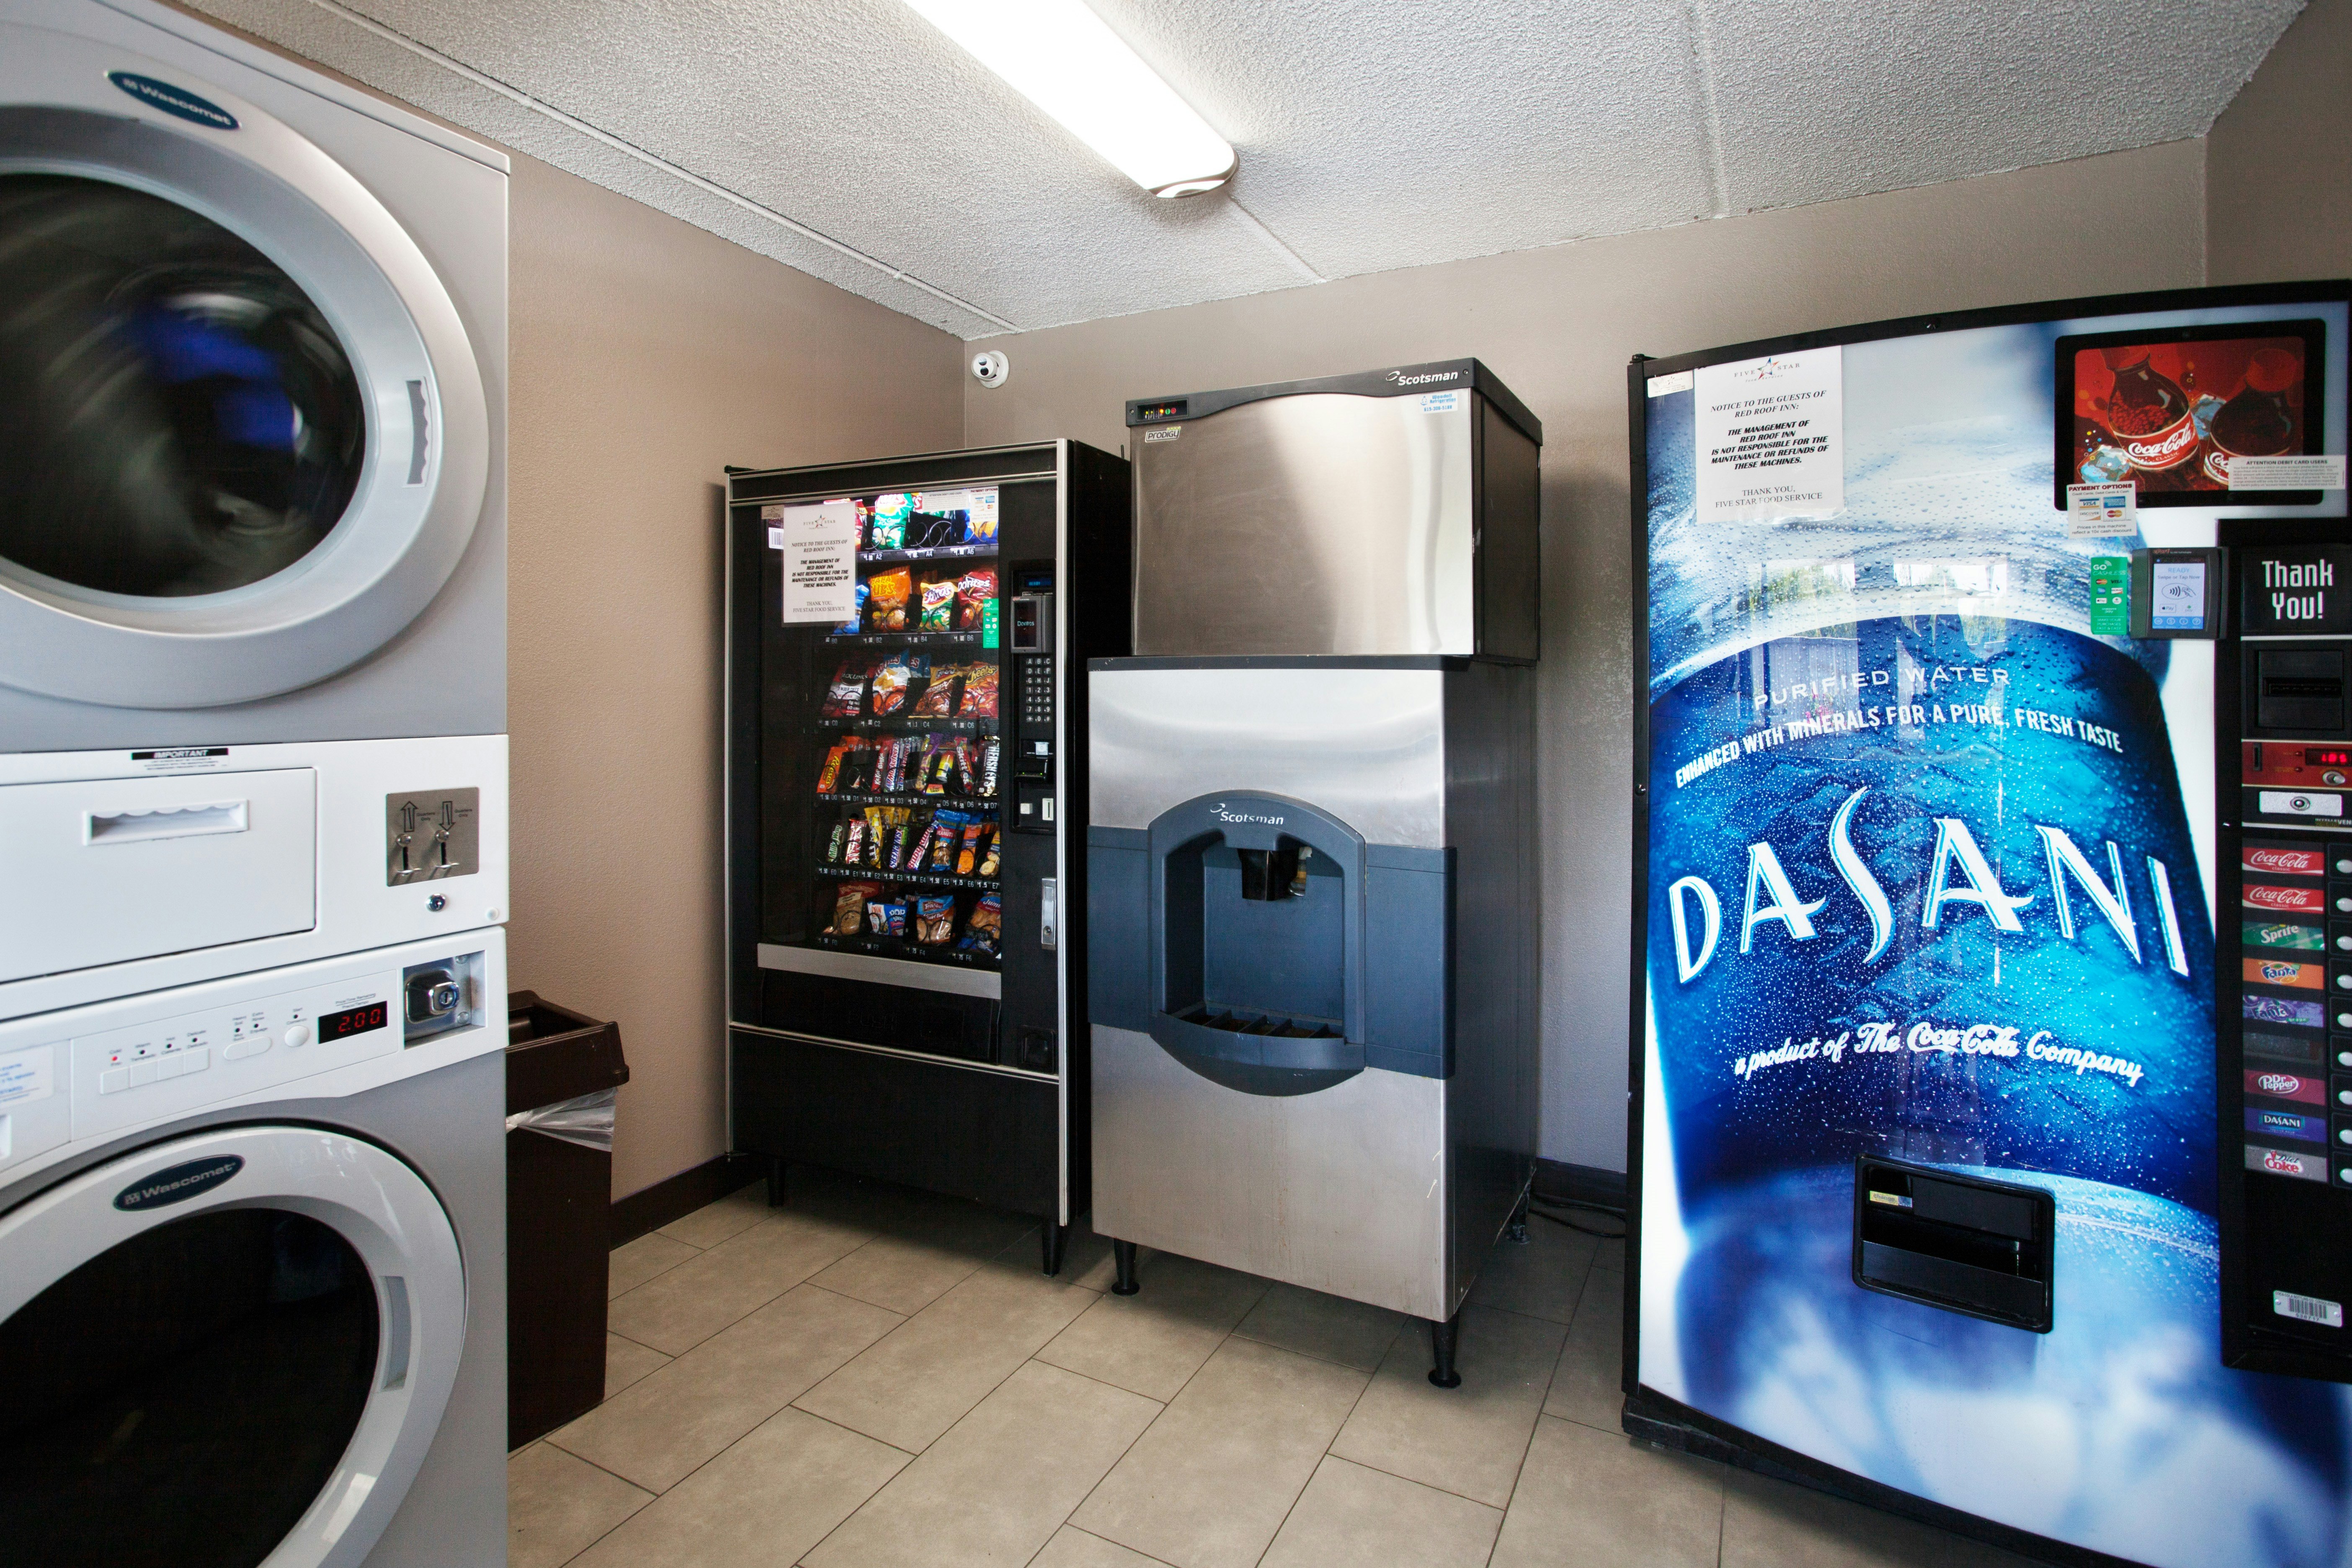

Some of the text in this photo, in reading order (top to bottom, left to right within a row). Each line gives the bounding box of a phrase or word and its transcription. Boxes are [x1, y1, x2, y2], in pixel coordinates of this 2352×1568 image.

[139, 85, 231, 125] Wascomat
[1398, 371, 1458, 386] Scotsman
[1711, 402, 1741, 413] NOTICE
[1777, 392, 1811, 402] GUESTS
[1754, 406, 1778, 415] ROOF
[1743, 421, 1797, 434] MANAGEMENT
[1758, 432, 1780, 441] ROOF
[2128, 420, 2192, 457] Coca-Cola
[1738, 440, 1791, 452] RESPONSIBLE
[1711, 452, 1762, 464] MAINTENANCE
[1777, 446, 1815, 456] REFUNDS
[2156, 452, 2179, 461] CLASSIC
[1734, 457, 1802, 470] THESE MACHINES.
[1742, 487, 1772, 496] THANK
[1785, 493, 1823, 502] SERVICE
[2262, 559, 2333, 588] Thank
[958, 576, 990, 592] Doritos
[2272, 591, 2324, 620] You!
[966, 665, 997, 684] Cheetos
[1754, 667, 2010, 712] PURIFIED WATER
[153, 750, 208, 758] IMPORTANT
[1675, 704, 2123, 789] ENHANCED WITH MINERALS FOR A PURE, FRESH TASTE
[984, 746, 1000, 787] HERSHEY'S
[1220, 811, 1284, 825] Scotsman
[2250, 851, 2312, 869] Coca-Cola
[1669, 786, 2189, 985] DASANI
[2249, 887, 2311, 905] Coca-Cola
[2260, 925, 2300, 944] Sprite
[2262, 966, 2296, 979] Fanta
[2251, 1003, 2289, 1019] Fanta
[338, 1008, 381, 1032] 2.00
[1735, 1021, 2145, 1088] a product of The Coca-Cola Company
[2259, 1075, 2297, 1091] Pepper
[2272, 1075, 2286, 1083] Dr
[2264, 1115, 2300, 1127] DASANI
[2265, 1157, 2299, 1173] Coke
[2279, 1154, 2299, 1163] Diet
[142, 1163, 233, 1199] Wascomat
